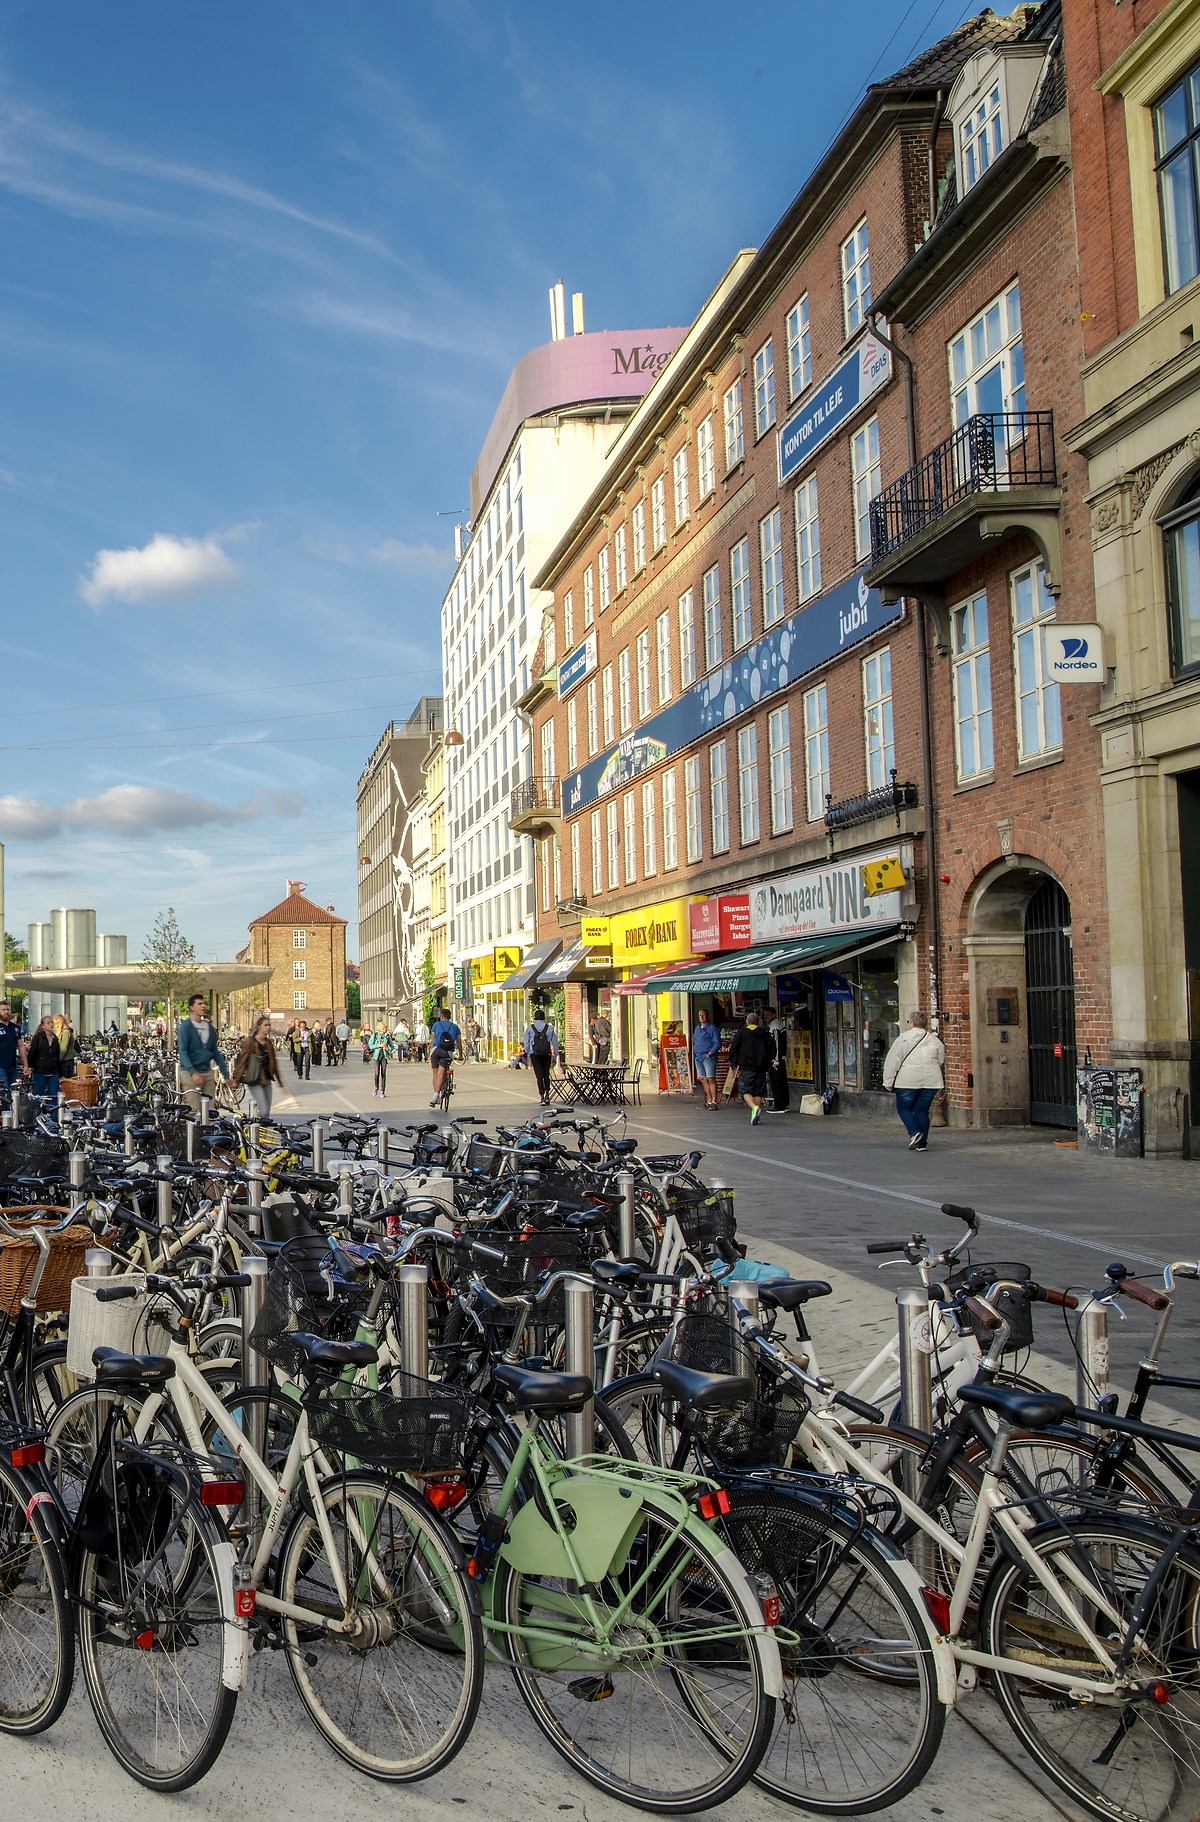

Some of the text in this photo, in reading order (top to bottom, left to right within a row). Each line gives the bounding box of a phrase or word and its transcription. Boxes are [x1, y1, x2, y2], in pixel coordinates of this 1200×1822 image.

[870, 353, 887, 378] DEAS
[784, 385, 844, 460] KONTOR TIL LEJE
[1054, 660, 1098, 670] Nordea
[769, 874, 824, 924] Damgaard
[625, 920, 677, 949] FOREX BANK
[732, 932, 749, 940] Isbar
[455, 981, 463, 999] FOTO
[267, 1496, 283, 1534] JUPITER
